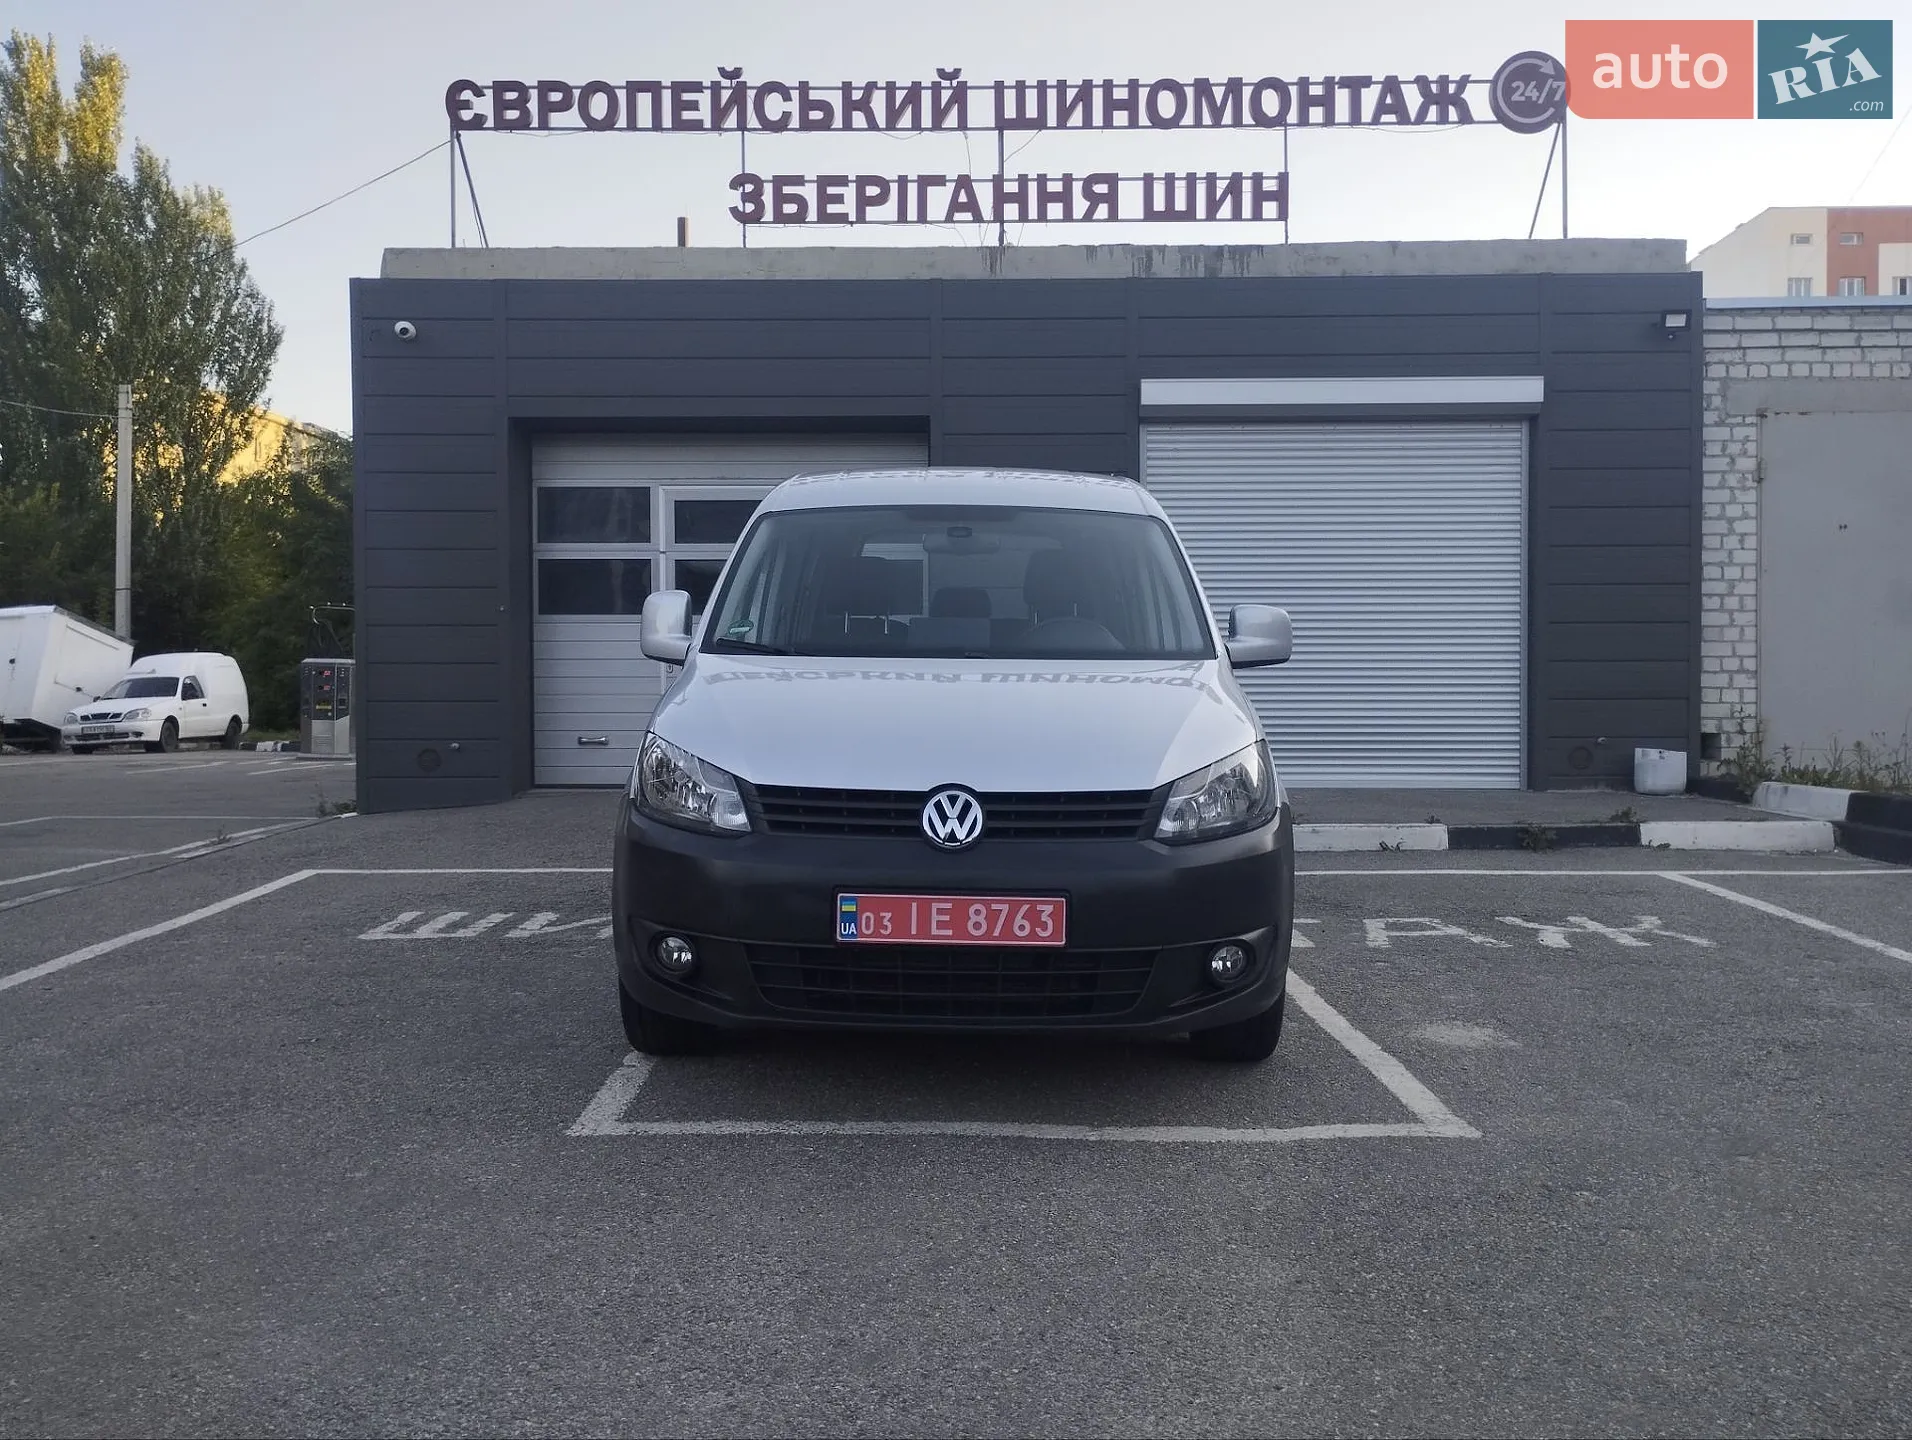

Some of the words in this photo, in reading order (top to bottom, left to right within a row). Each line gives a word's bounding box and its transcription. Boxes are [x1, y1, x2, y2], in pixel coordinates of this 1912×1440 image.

[445, 66, 969, 130] ЄВРОПЕЙСЬКИЙ
[995, 74, 1474, 130] ШИНОМОНТАЖ
[1511, 79, 1566, 105] 24/7
[729, 172, 1119, 224] ЗБЕРІГАННЯ
[1143, 172, 1288, 222] ШИН
[922, 789, 983, 846] VW
[841, 922, 857, 935] UA
[861, 912, 892, 935] 03
[911, 902, 953, 936] IE
[967, 903, 1054, 938] 8763
